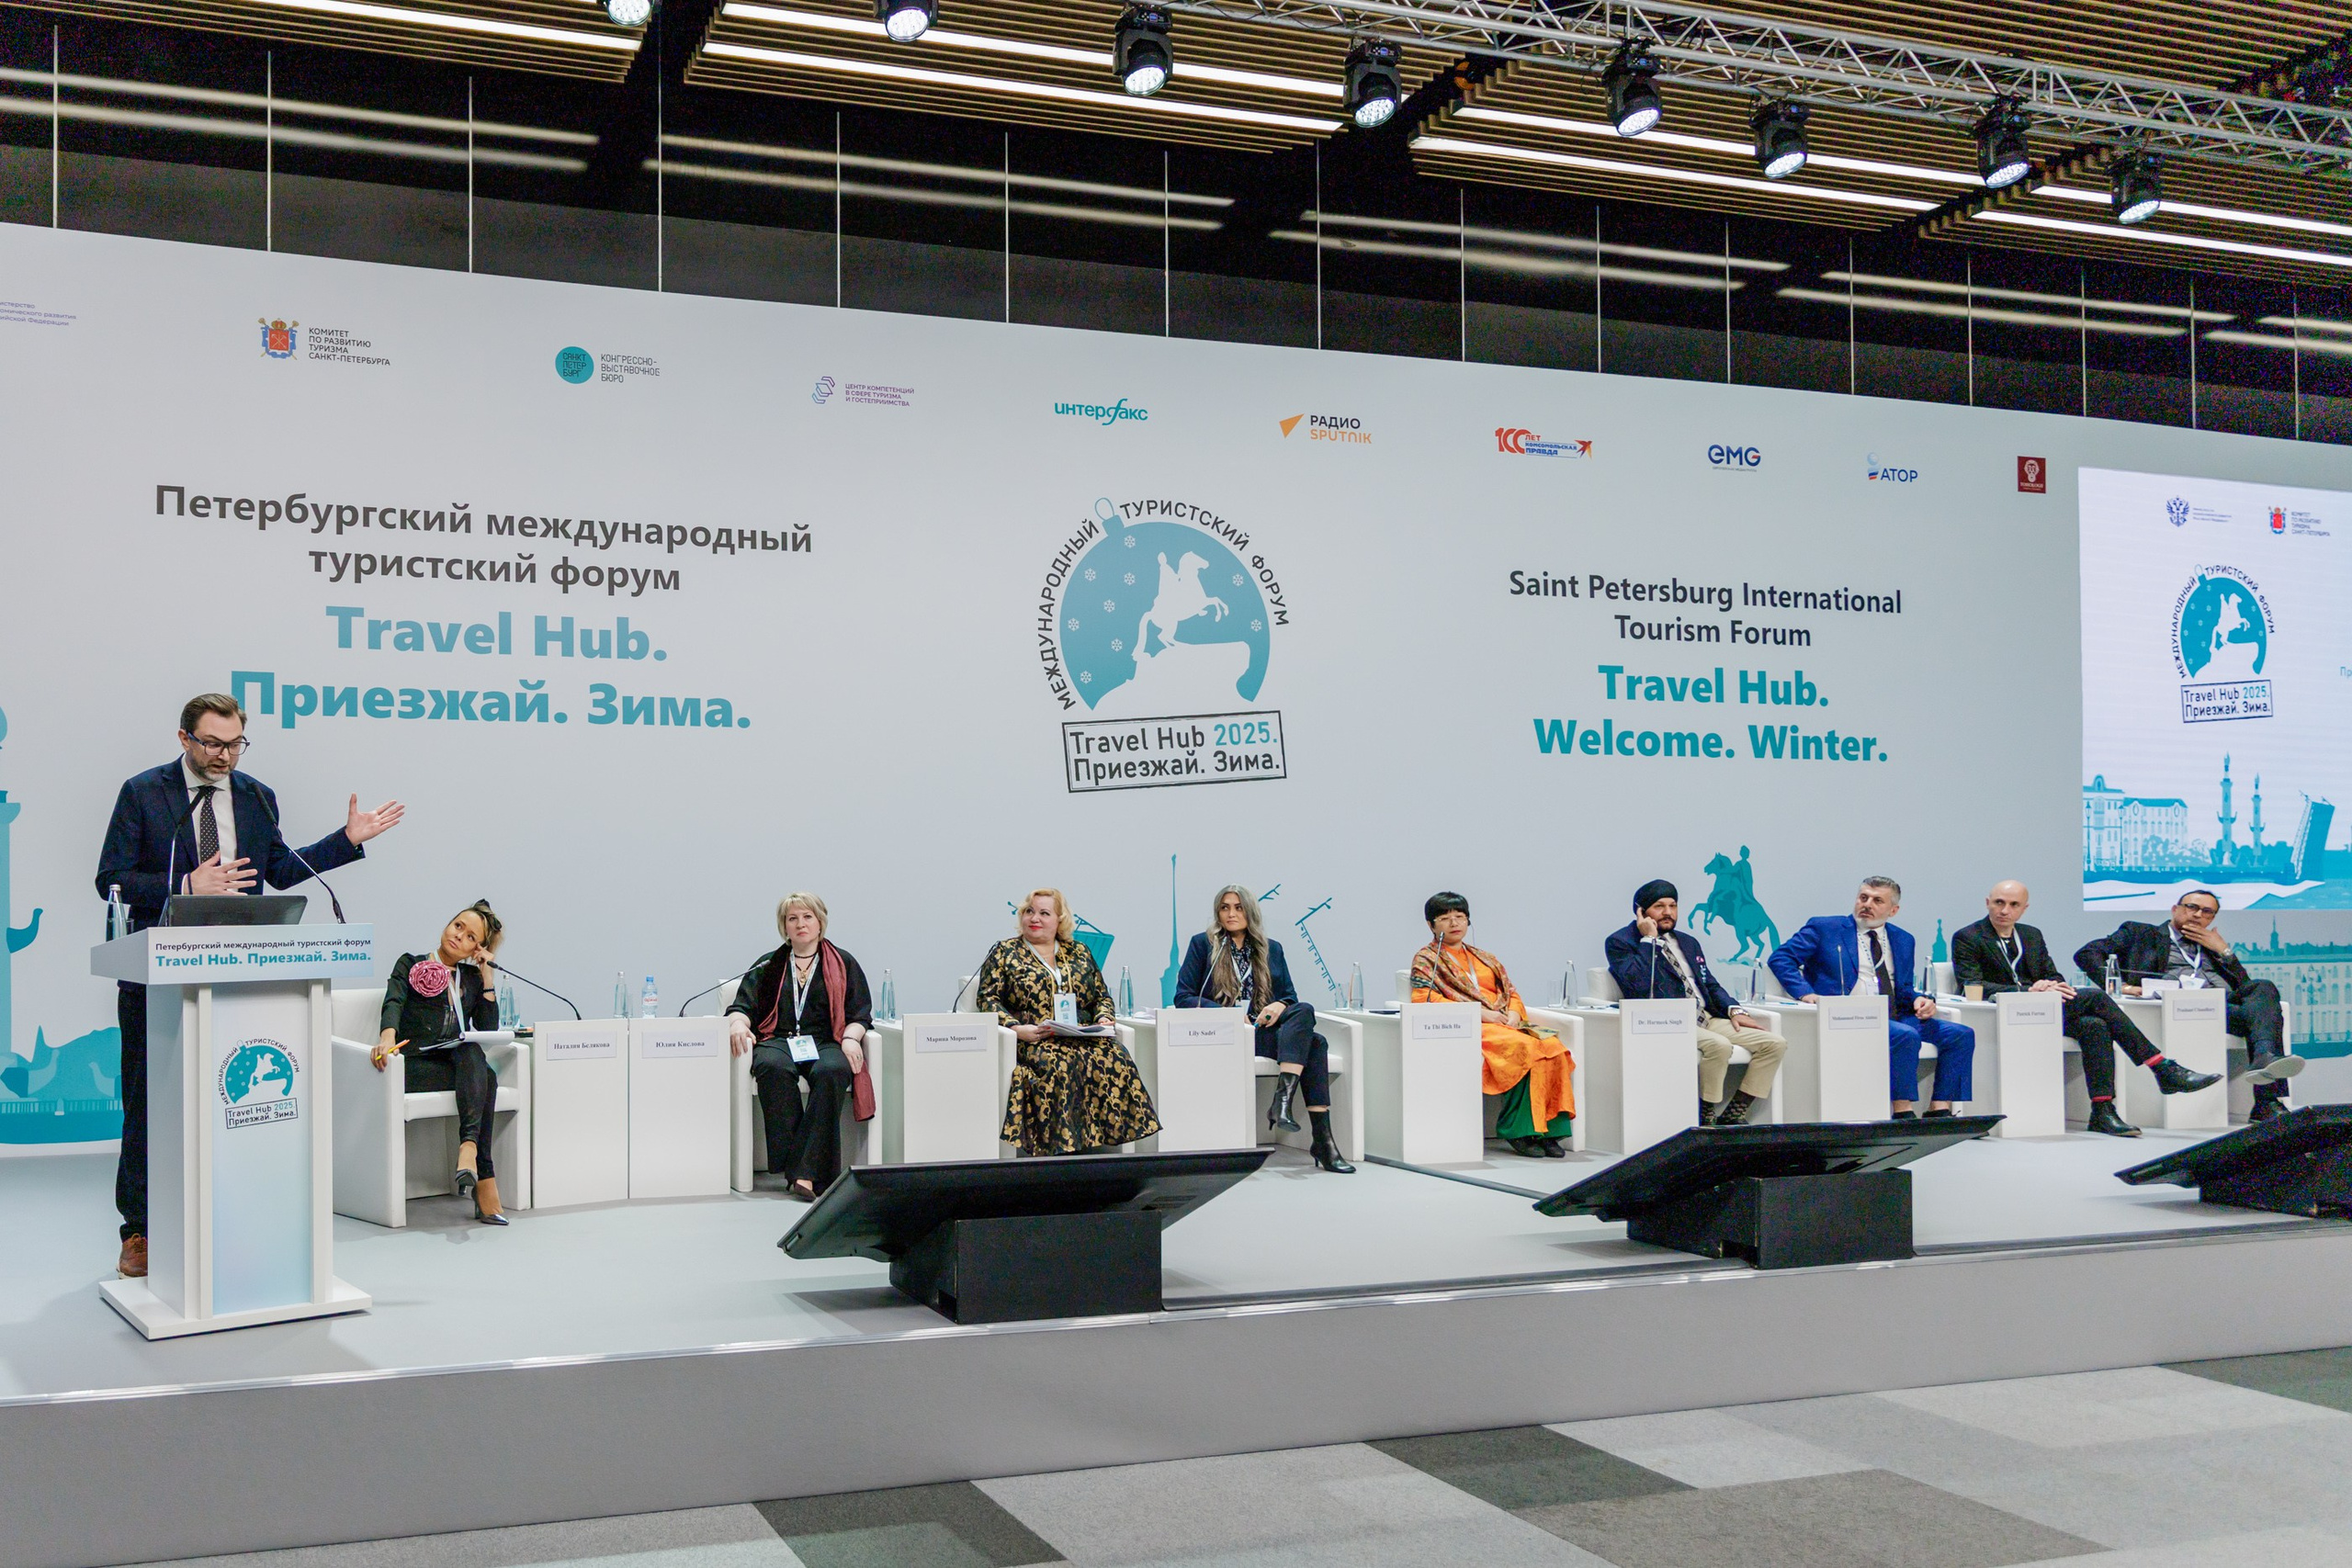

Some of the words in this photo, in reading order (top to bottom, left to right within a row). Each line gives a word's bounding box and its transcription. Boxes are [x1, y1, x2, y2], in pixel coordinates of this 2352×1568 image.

[309, 327, 349, 338] КОМИТЕТ
[309, 344, 349, 354] ТУРИЗМА
[323, 337, 371, 347] РАЗВИТИЮ
[309, 353, 390, 366] САНКТ-ПЕТЕРБУРГА
[562, 353, 586, 361] САНКТ
[601, 354, 657, 366] КОНГРЕССНО-
[562, 361, 586, 369] ПЕТЕР
[601, 364, 660, 376] ВЫСТАВОЧНОЕ
[562, 369, 582, 378] БУРГ
[601, 373, 624, 383] БЮРО
[867, 385, 914, 394] КОМПЕТЕНЦИЙ
[852, 397, 910, 407] ГОСТЕПРИИМСТВА
[1310, 415, 1360, 430] РАДИО
[1310, 429, 1372, 444] SPUTNIK
[1881, 468, 1917, 482] АТОР
[156, 485, 471, 535] Петербургский
[487, 514, 811, 555] международный
[309, 551, 537, 583] туристский
[550, 557, 680, 597] форум
[1510, 570, 1579, 598] Saint
[1589, 574, 1734, 612] Petersburg
[1743, 582, 1902, 614] International
[1037, 518, 1100, 710] МЕЖДУНАРОДНЫЙ
[1119, 500, 1250, 551] ТУРИСТСКИЙ
[1251, 555, 1289, 626] ФОРУМ
[2171, 575, 2197, 679] МЕЖДУНАРОДНЫЙ
[2205, 565, 2259, 593] ТУРИСТСКИЙ
[2258, 595, 2275, 634] ФОРУМ
[325, 605, 512, 655] Travel
[535, 615, 667, 661] Hub.
[1614, 615, 1720, 643] Tourism
[1731, 619, 1811, 647] Forum
[1598, 665, 1724, 703] Travel
[1738, 670, 1828, 707] Hub.
[231, 671, 568, 729] Приезжай.
[587, 682, 752, 728] Зима.
[2184, 689, 2216, 703] Travel
[2220, 687, 2240, 700] Hub
[2243, 685, 2269, 698] 2025.
[2185, 701, 2240, 719] Приезжай.
[2243, 701, 2270, 713] Зима.
[1069, 728, 1148, 754] Travel
[1158, 726, 1204, 750] Hub
[1214, 721, 1277, 746] 2025.
[1533, 718, 1736, 759] Welcome.
[1747, 724, 1888, 762] Winter.
[1074, 750, 1205, 785] Приезжай.
[1214, 750, 1280, 772] Зима.
[155, 942, 221, 951] Петербургский
[223, 941, 294, 951] международный
[297, 939, 342, 948] туристский
[344, 939, 370, 947] форум
[155, 954, 202, 966] Travel
[208, 953, 243, 964] Hub.
[248, 951, 326, 966] Приезжай.
[331, 951, 371, 962] Зима.
[218, 1047, 239, 1105] МЕЖДУНАРОДНЫЙ
[245, 1038, 288, 1051] ТУРИСТСКИЙ
[288, 1052, 300, 1073] ФОРУМ
[228, 1108, 254, 1117] Travel
[255, 1105, 272, 1114] Hub
[275, 1102, 295, 1111] 2025.
[229, 1112, 272, 1126] Приезжай.
[274, 1111, 296, 1119] Зима.
